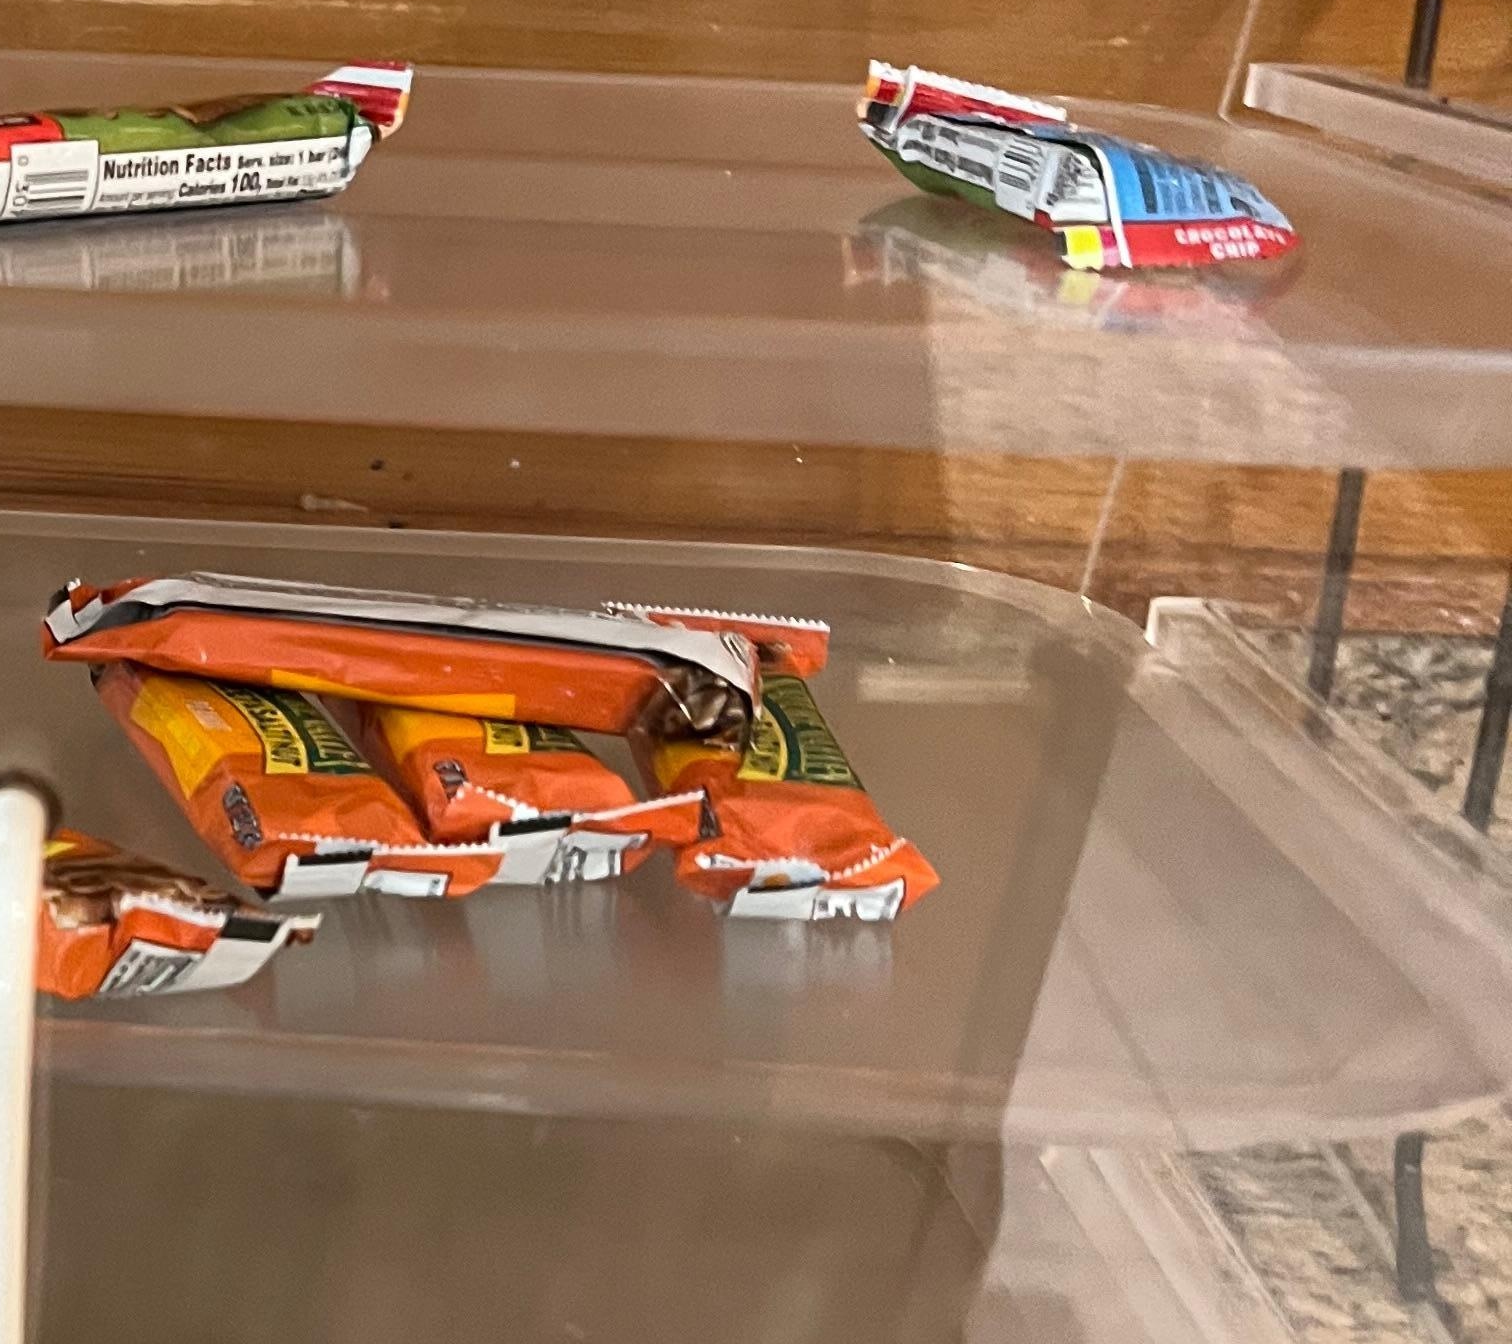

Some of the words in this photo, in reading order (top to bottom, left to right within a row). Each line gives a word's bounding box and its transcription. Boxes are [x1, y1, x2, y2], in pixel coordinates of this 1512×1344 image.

[103, 160, 179, 181] Nutrition
[185, 154, 231, 174] Facts
[232, 172, 261, 194] 100,
[1174, 223, 1287, 246] CHOCOLATE
[1209, 241, 1260, 260] CHIP
